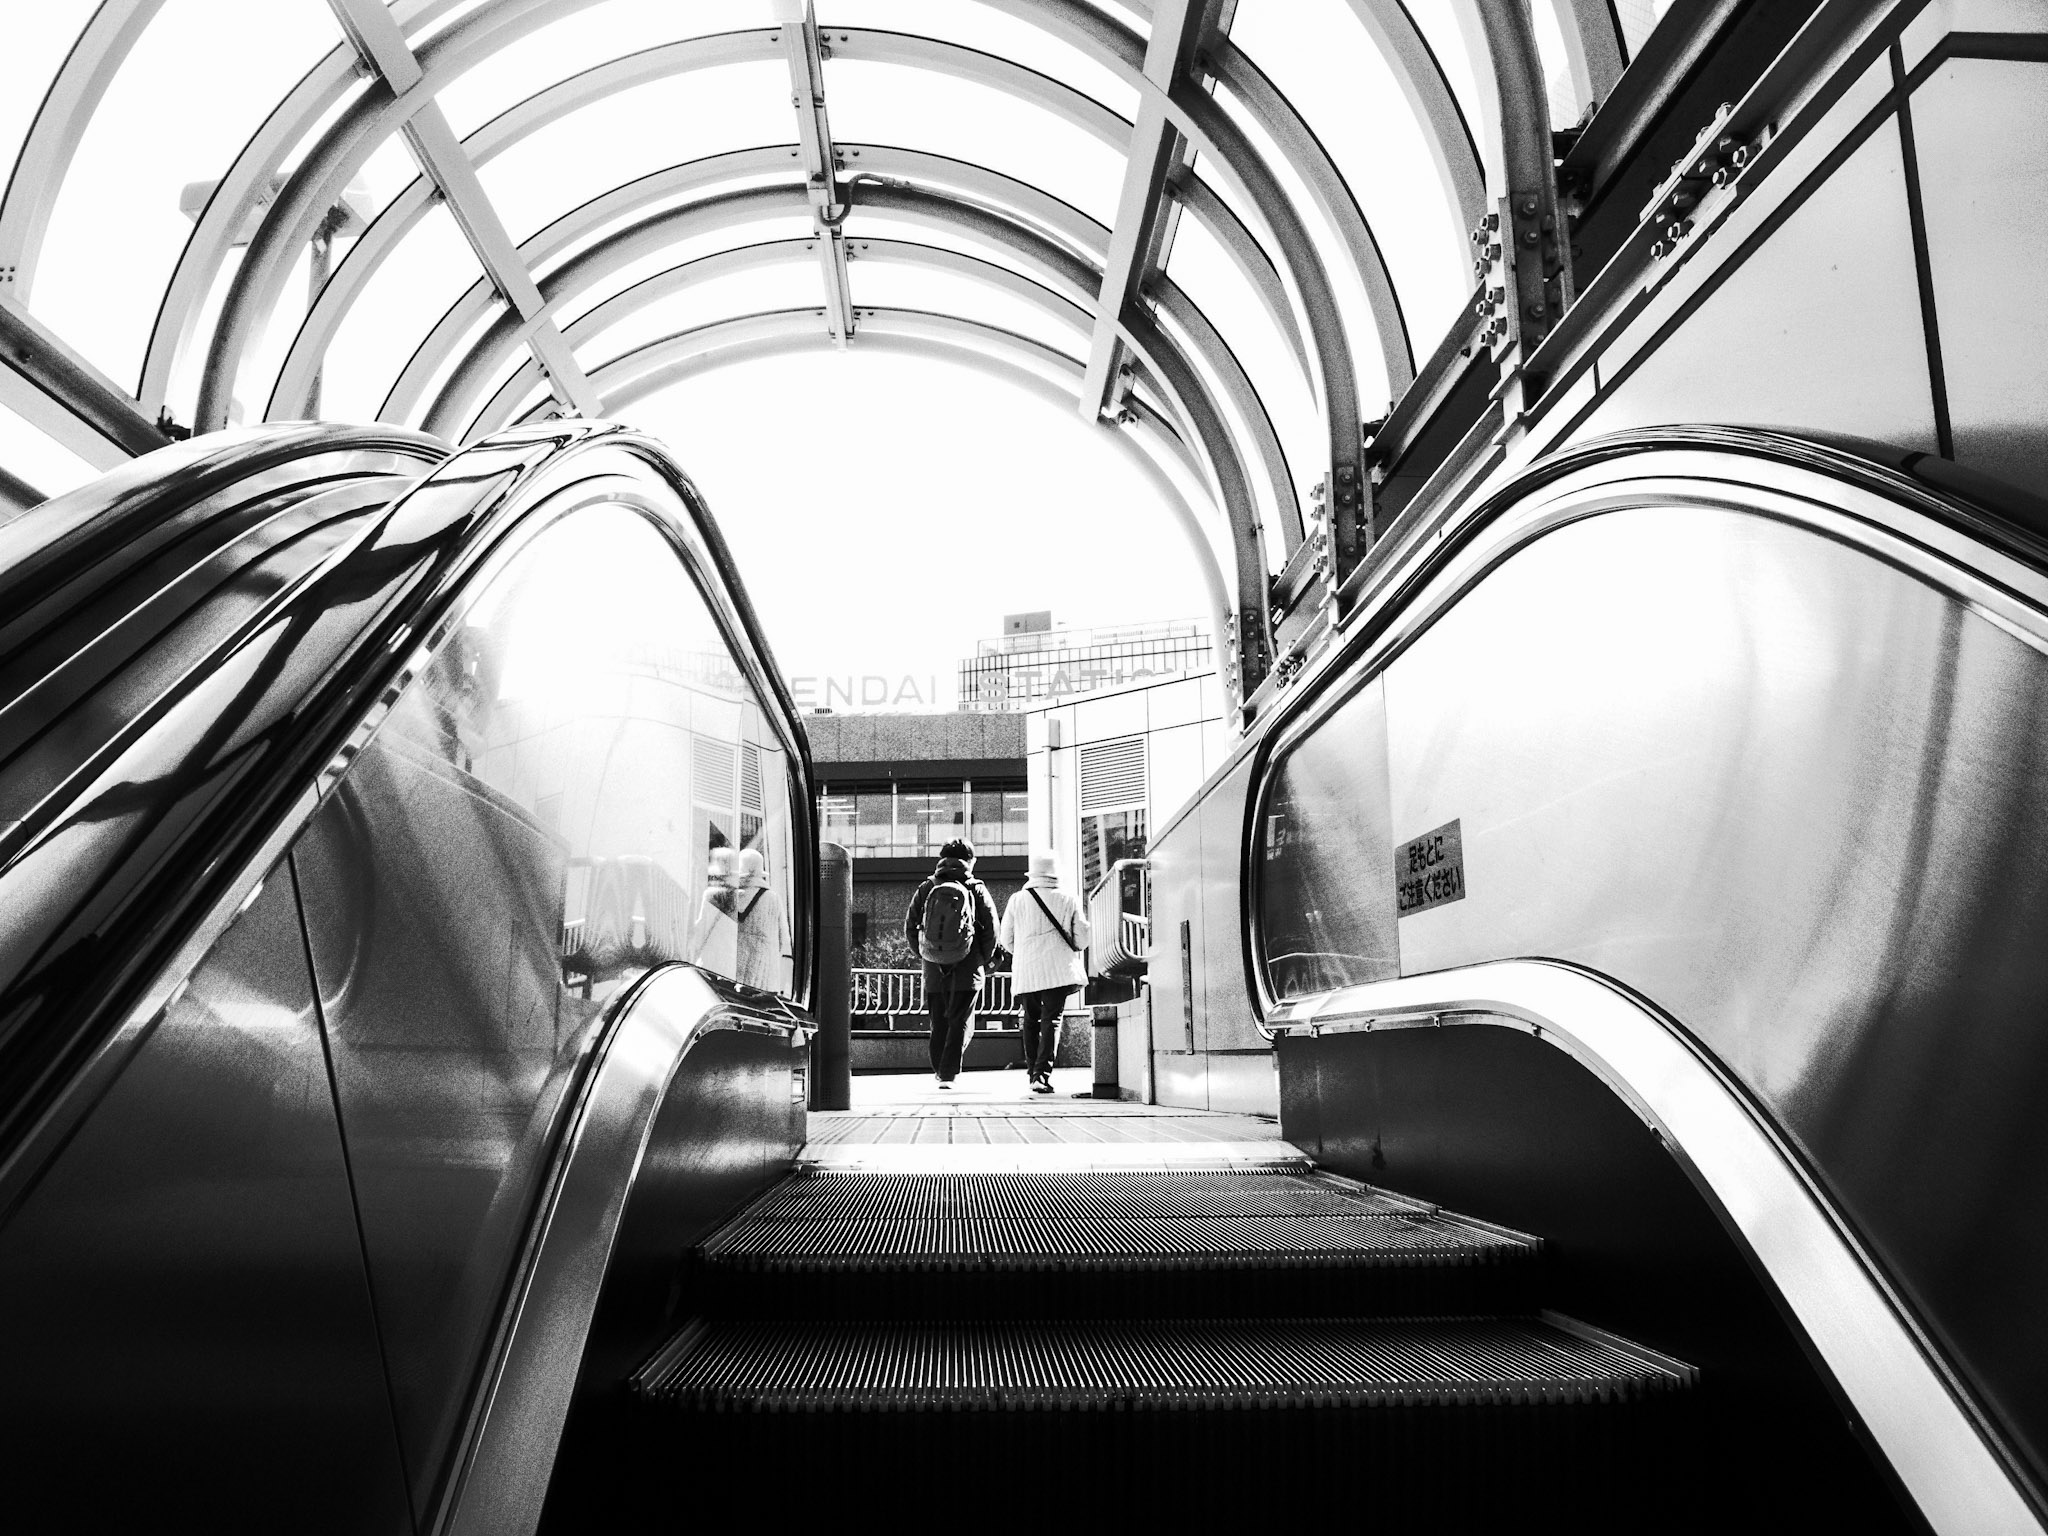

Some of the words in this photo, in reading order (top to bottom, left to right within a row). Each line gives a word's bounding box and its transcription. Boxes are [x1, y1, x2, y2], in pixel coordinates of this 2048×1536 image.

[790, 675, 936, 706] ENDAI
[1409, 836, 1444, 874] 足もとに
[1400, 867, 1461, 910] ご注意ください
